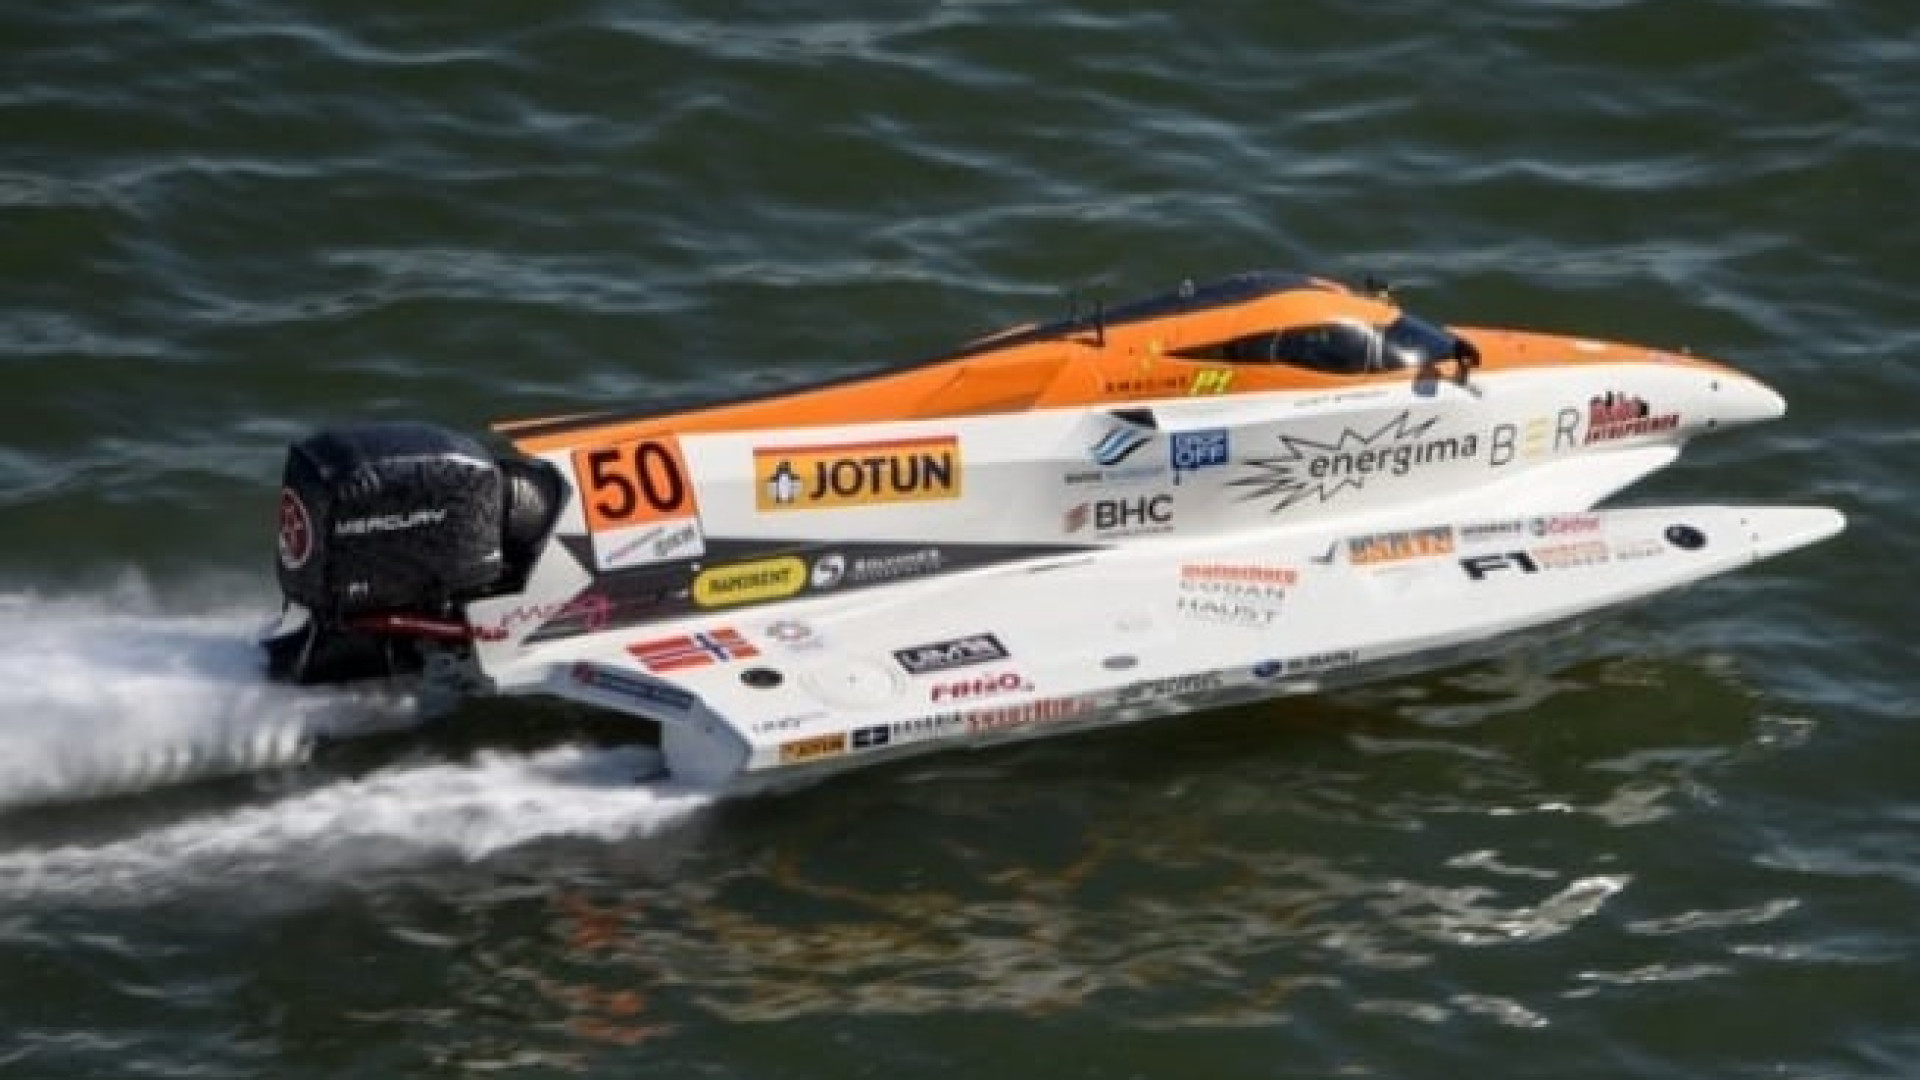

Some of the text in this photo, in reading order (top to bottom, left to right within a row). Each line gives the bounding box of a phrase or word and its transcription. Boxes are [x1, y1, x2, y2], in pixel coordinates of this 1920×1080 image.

[1175, 446, 1224, 466] OFF
[1308, 433, 1478, 476] energima
[588, 441, 683, 519] 50
[808, 452, 951, 500] JOTUN
[335, 509, 447, 534] MERCURY
[1095, 494, 1174, 530] BHC
[1458, 550, 1539, 580] F1
